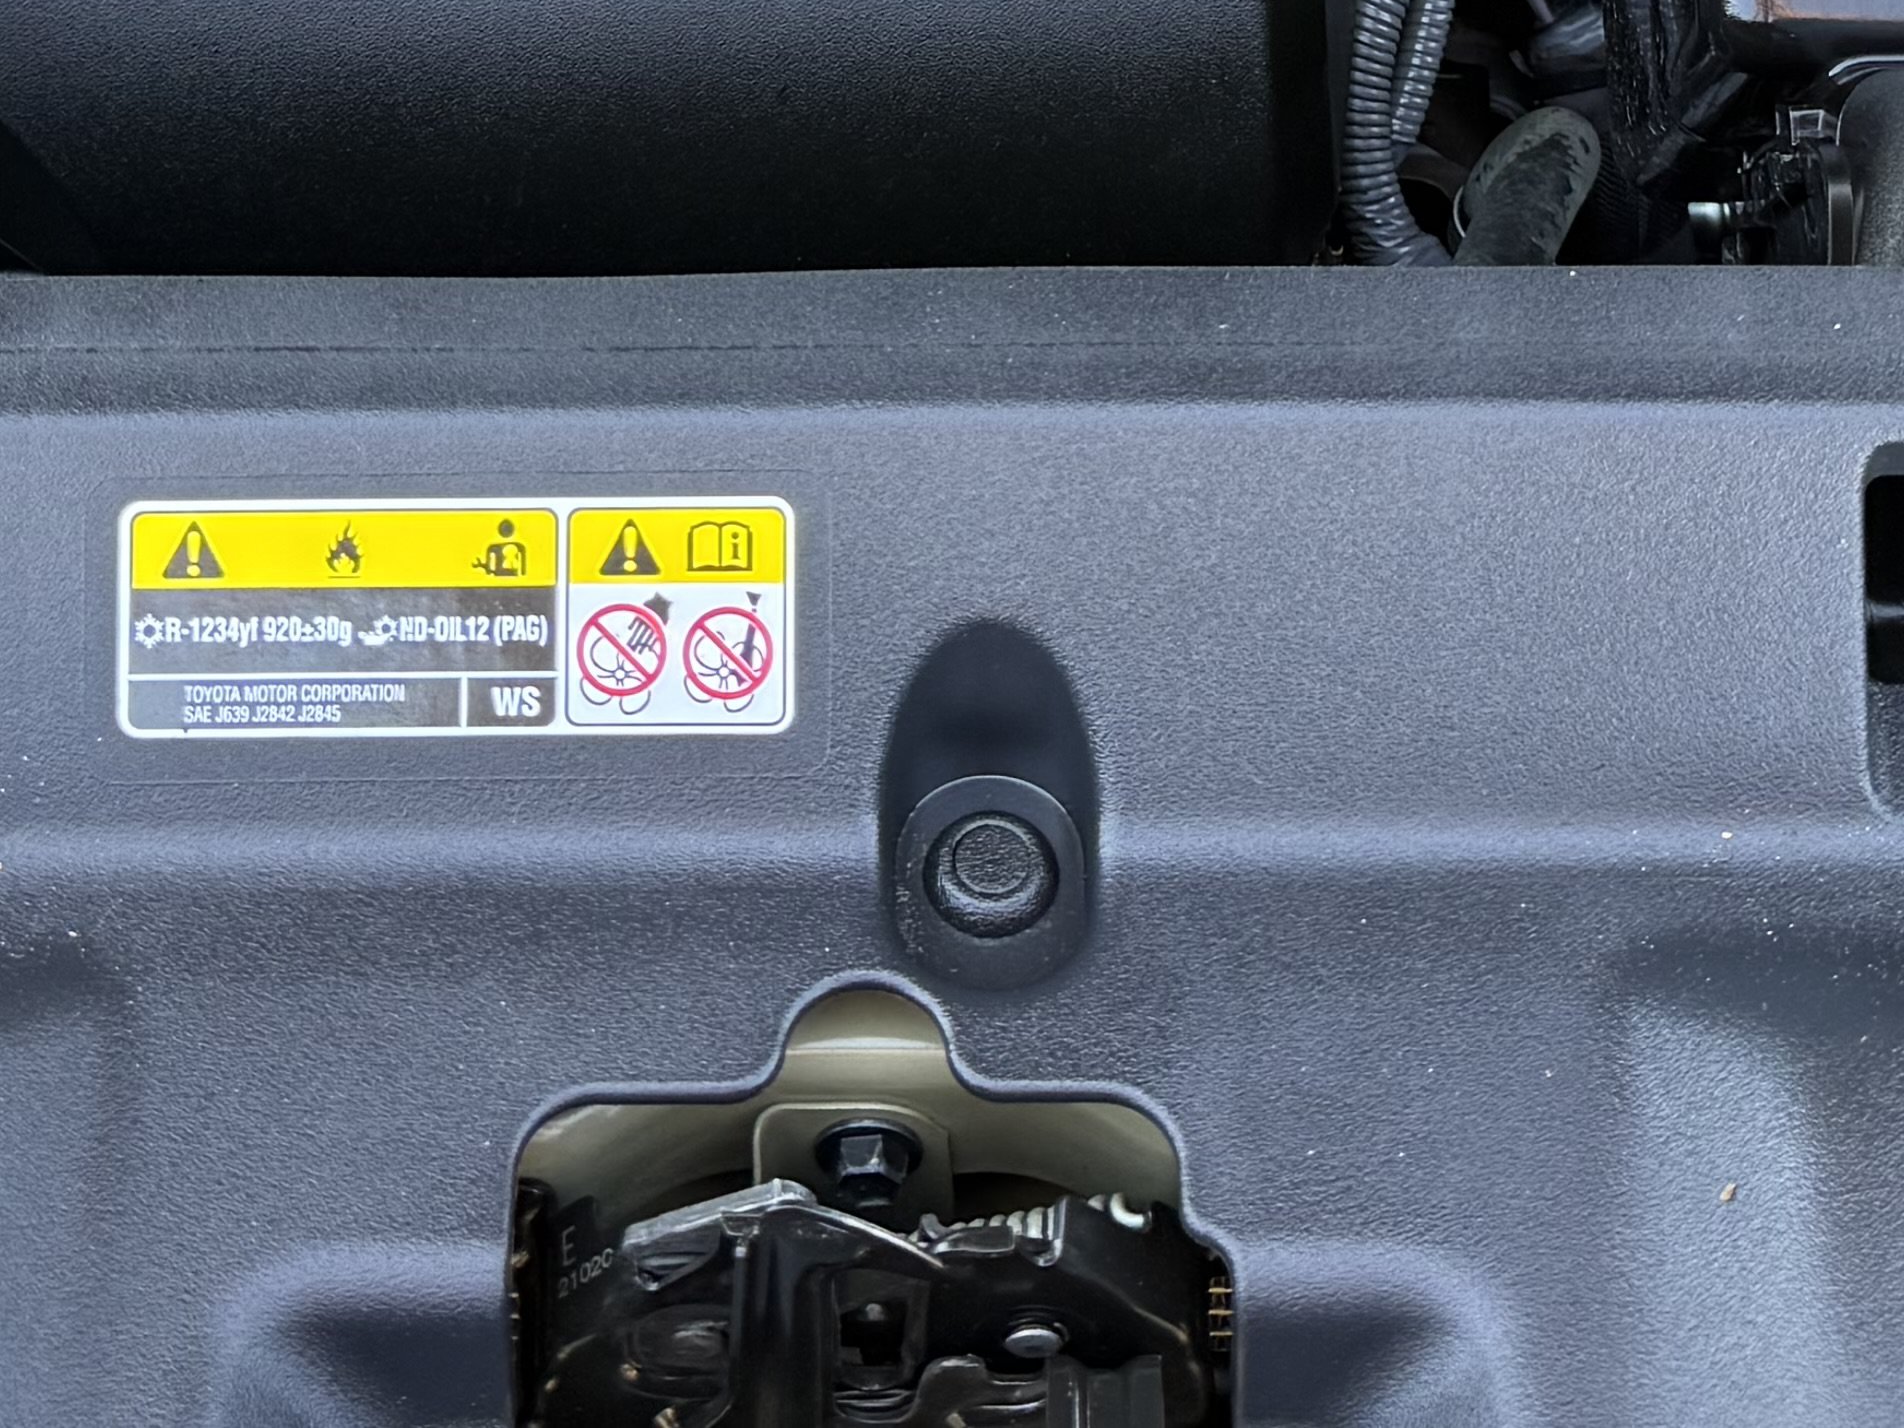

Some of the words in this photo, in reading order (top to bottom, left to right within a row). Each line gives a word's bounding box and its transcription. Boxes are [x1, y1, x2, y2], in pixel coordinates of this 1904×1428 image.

[164, 616, 259, 648] R-1234yf
[262, 616, 352, 648] 920±30g
[493, 614, 548, 648] (PAG)
[183, 684, 241, 703] TOYOTA
[243, 684, 297, 702] MOTOR
[300, 683, 406, 702] CORPORATION
[490, 686, 543, 718] WS
[183, 705, 212, 724] SAE
[214, 705, 250, 724] J639
[252, 704, 296, 723] J2842
[298, 704, 342, 723] J2845
